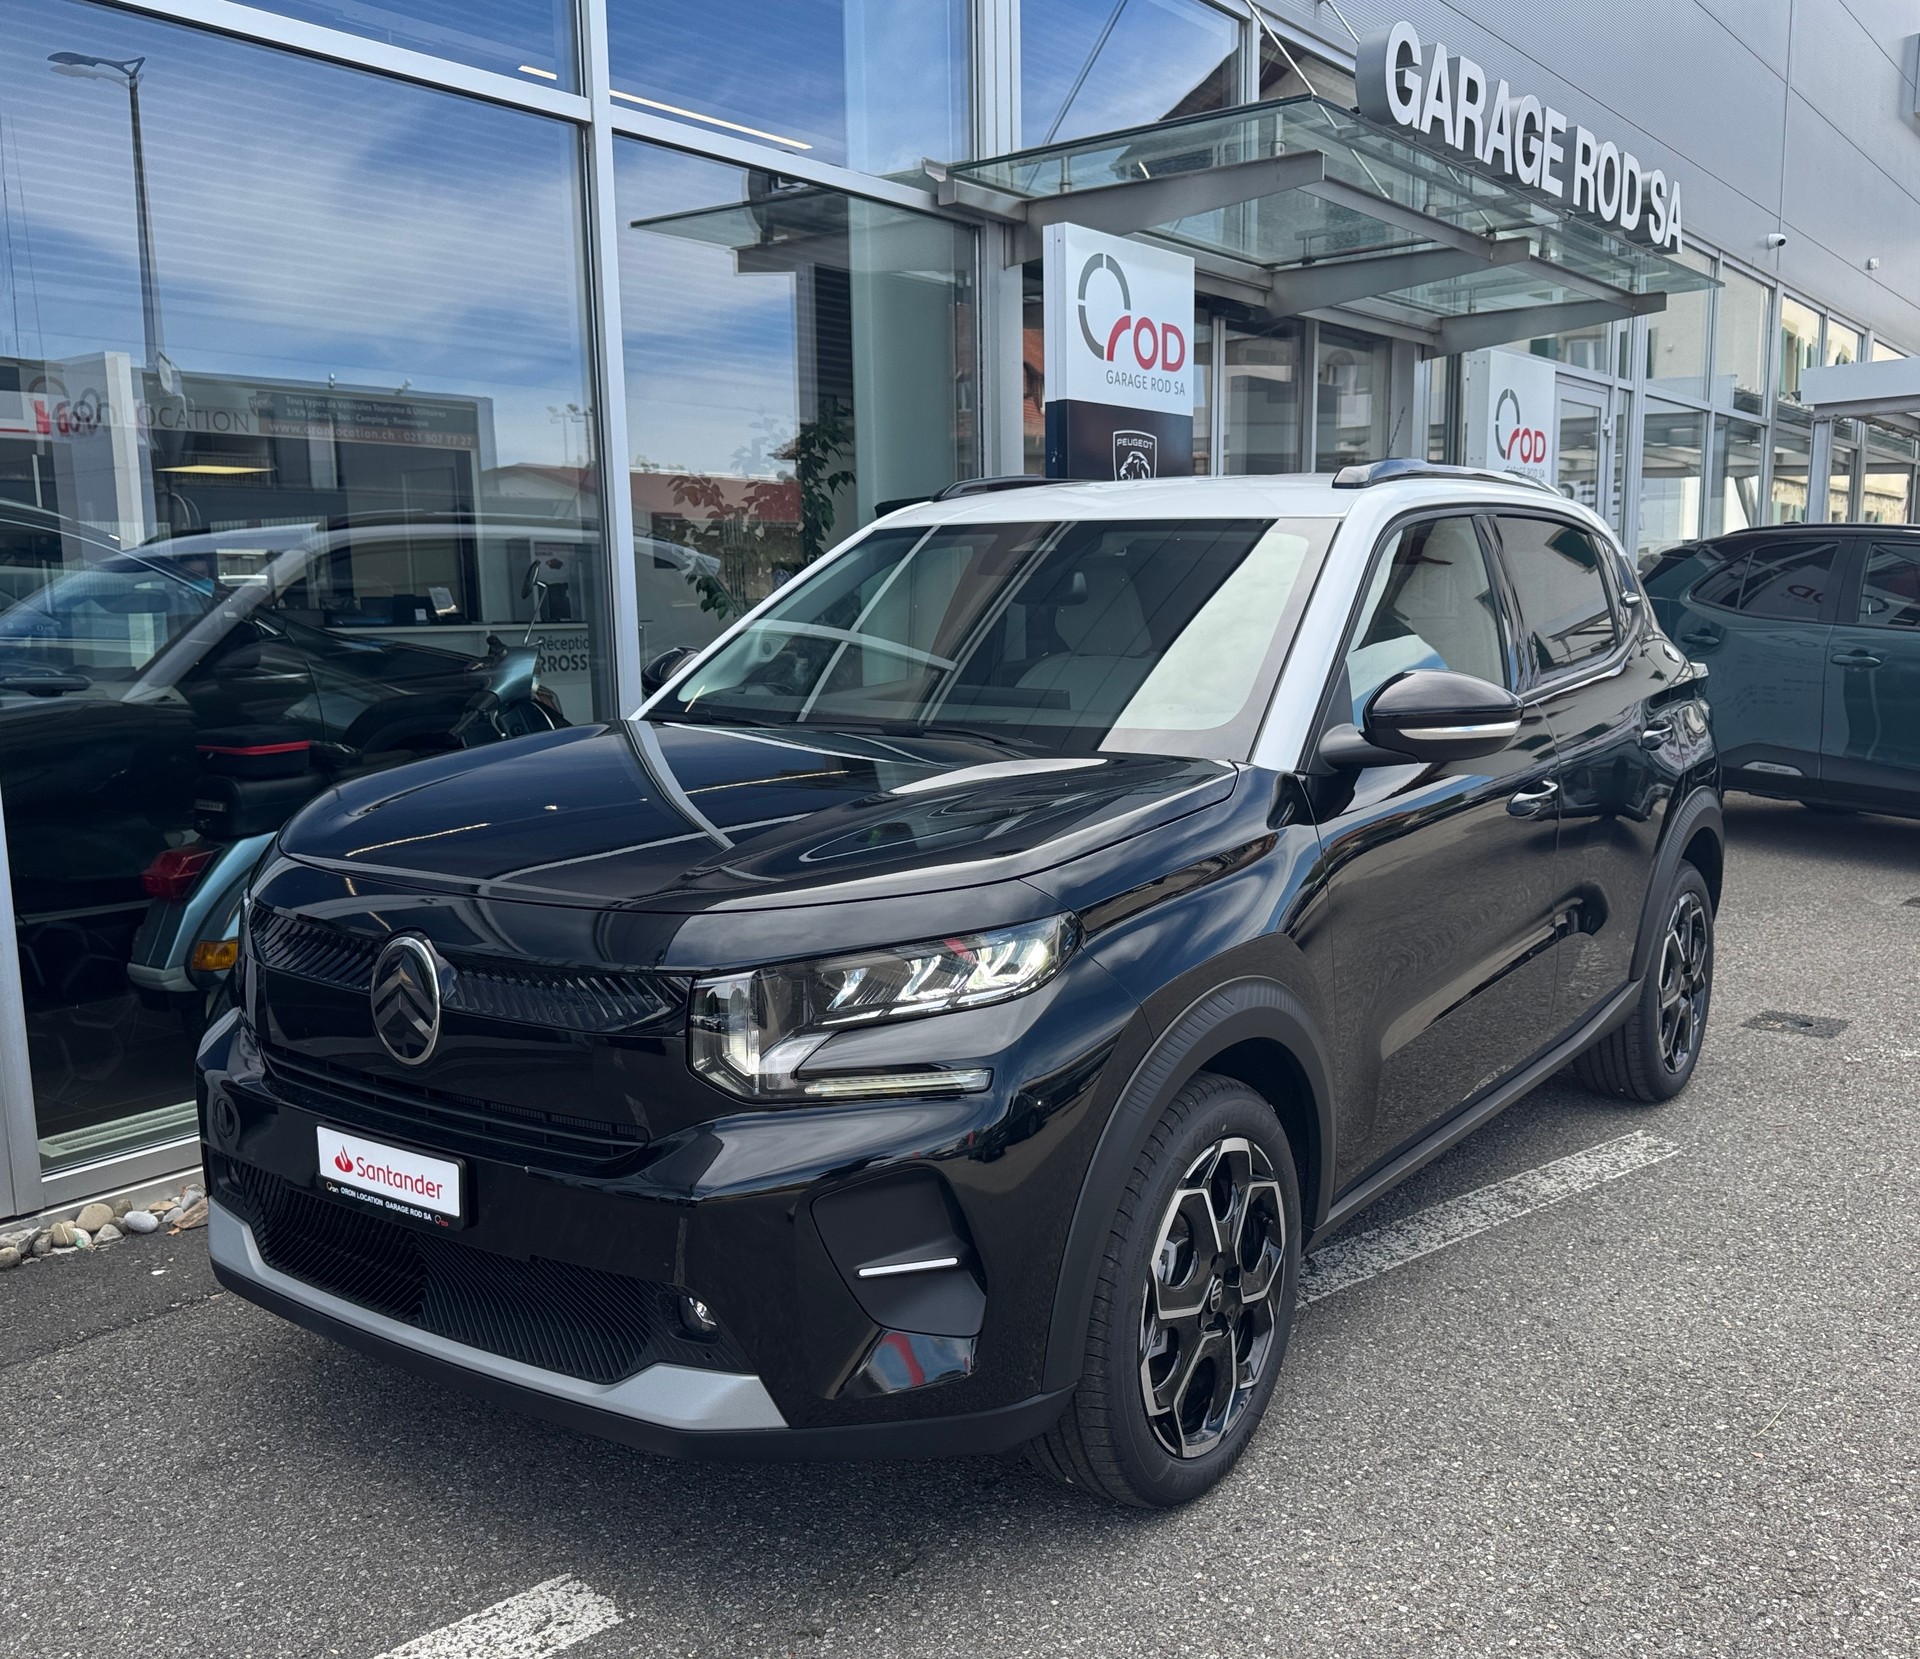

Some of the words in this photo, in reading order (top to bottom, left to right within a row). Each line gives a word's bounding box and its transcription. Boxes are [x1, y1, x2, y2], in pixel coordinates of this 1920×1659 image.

[1385, 20, 1567, 198] GARAGE
[1572, 125, 1642, 231] ROD
[1648, 168, 1683, 253] SA
[1106, 370, 1148, 390] GARAGE
[1150, 377, 1171, 393] ROD
[1174, 382, 1186, 396] SA
[1116, 438, 1154, 449] PEUGEOT
[356, 1156, 443, 1199] Santander
[356, 1191, 384, 1206] LOCATION
[385, 1200, 409, 1214] GARAGE
[409, 1208, 422, 1218] ROD
[423, 1212, 432, 1221] SA
